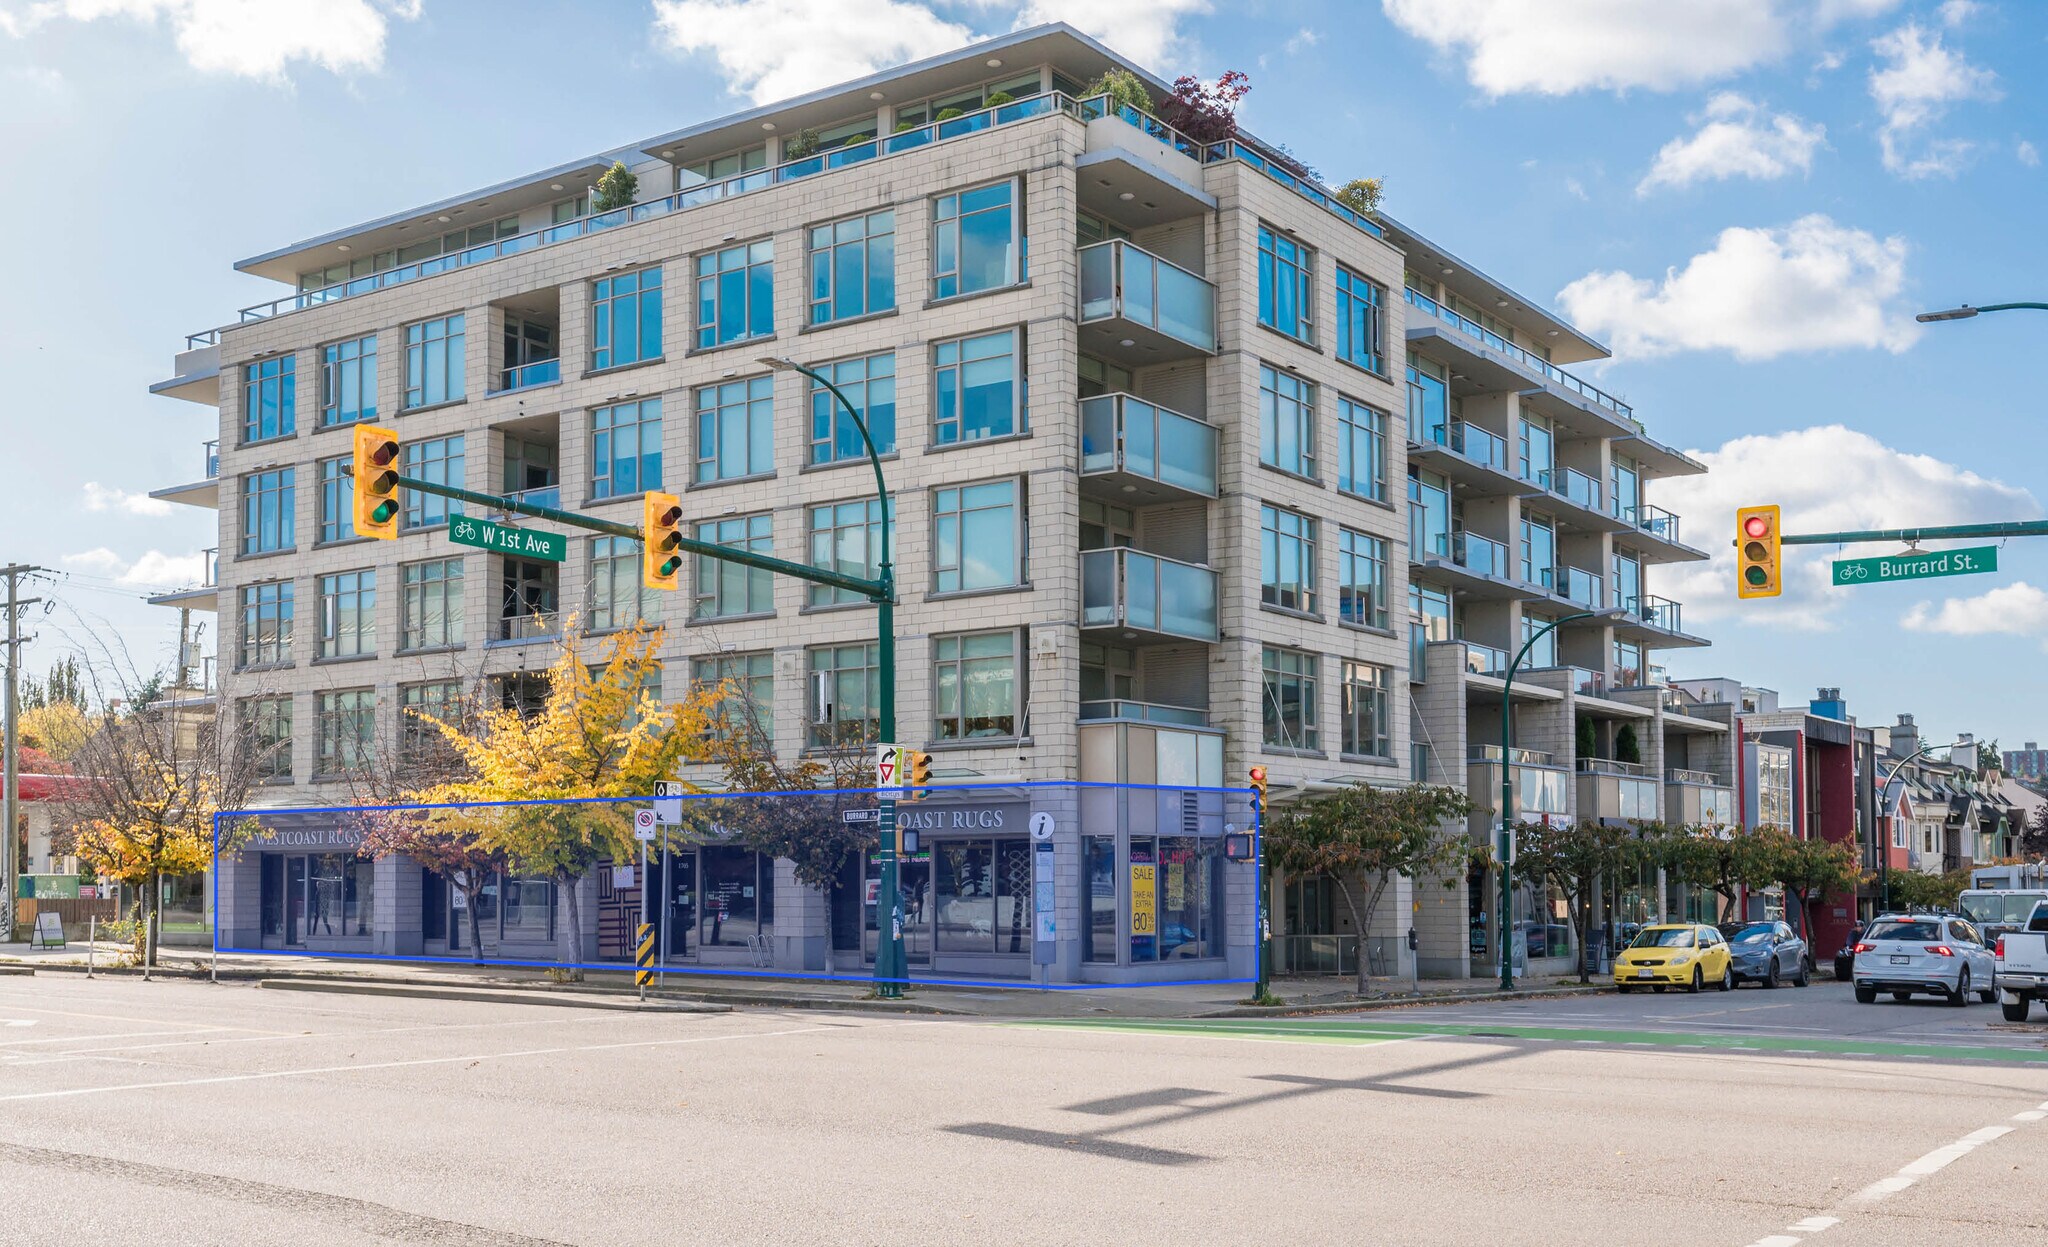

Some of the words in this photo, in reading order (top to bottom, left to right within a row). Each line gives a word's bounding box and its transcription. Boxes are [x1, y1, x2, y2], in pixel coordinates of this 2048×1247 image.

[482, 525, 495, 544] W
[499, 530, 520, 549] 1st
[525, 534, 550, 554] Ave
[1880, 555, 1948, 577] Burrard
[1953, 554, 1979, 571] St.
[846, 811, 868, 820] BURRARD
[951, 810, 1003, 828] RUGS
[1038, 816, 1046, 835] i
[327, 829, 361, 844] RUGS
[1133, 867, 1153, 880] SALE
[1133, 891, 1146, 899] TAKE
[1147, 891, 1154, 899] AN
[1135, 900, 1152, 908] EXTRA
